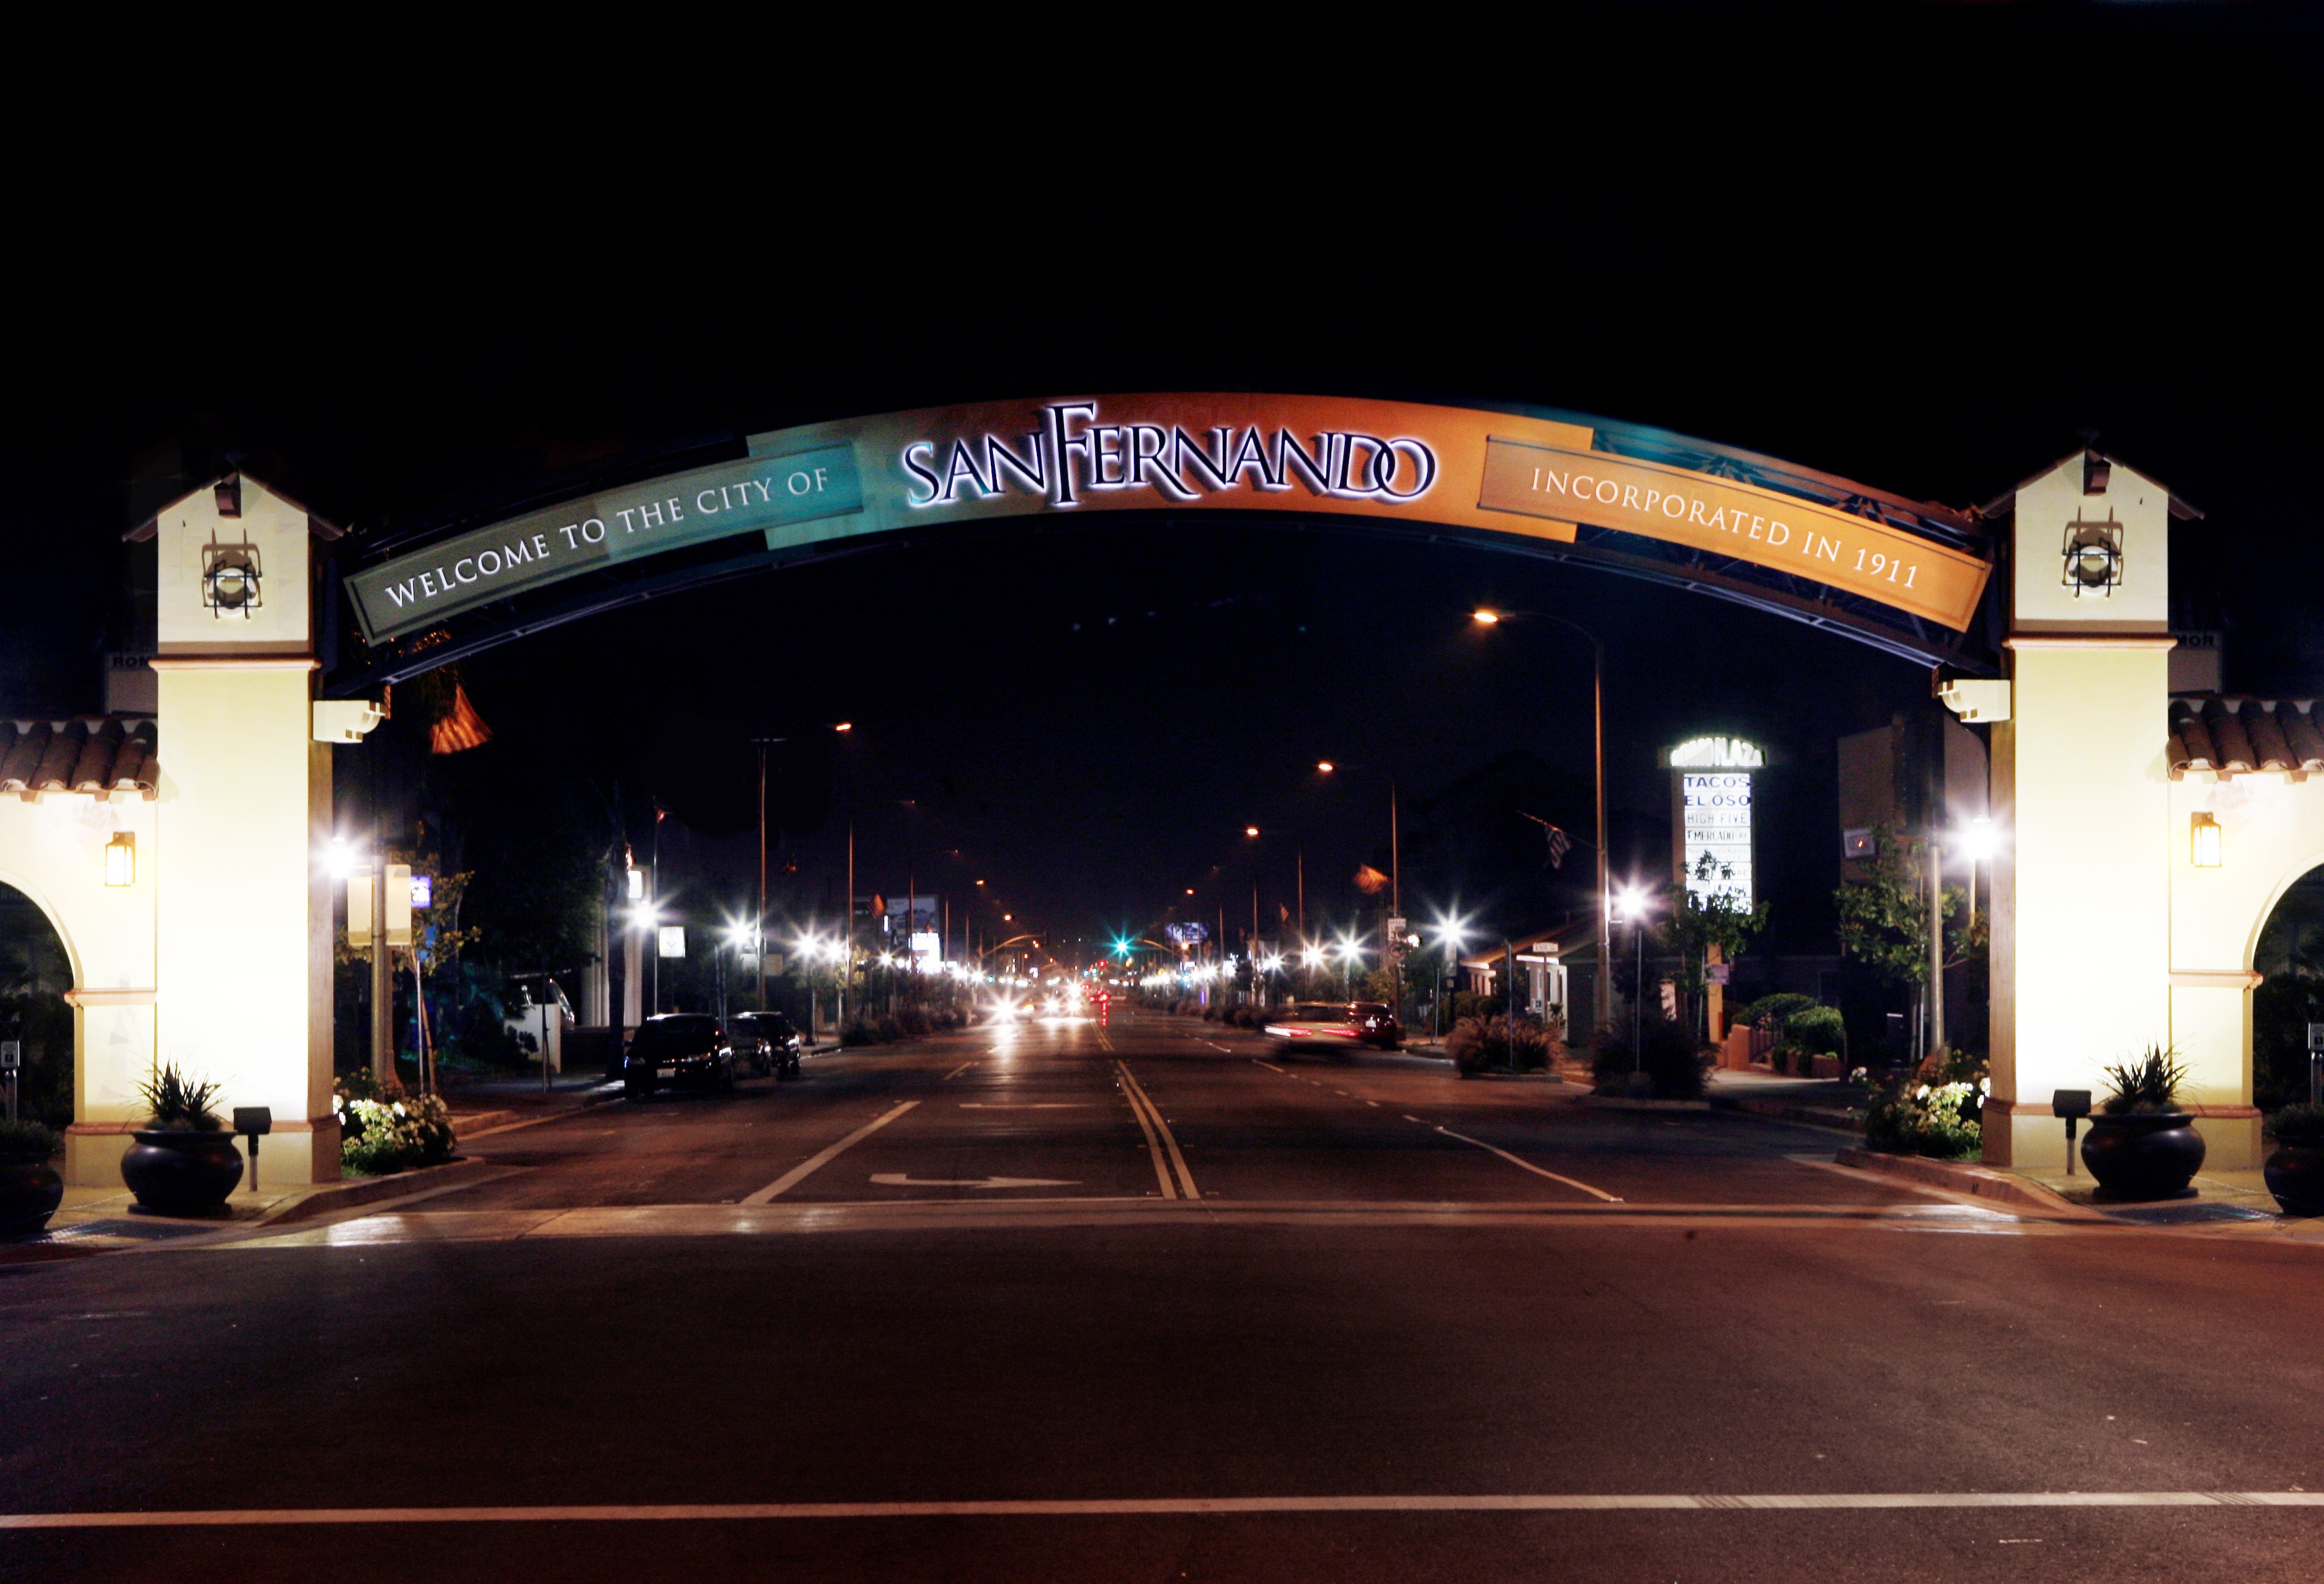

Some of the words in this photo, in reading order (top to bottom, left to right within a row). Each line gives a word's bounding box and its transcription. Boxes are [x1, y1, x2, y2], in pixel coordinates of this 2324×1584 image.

[903, 433, 1046, 507] SAN
[1048, 401, 1437, 505] FERNANDO
[1531, 468, 1790, 546] INCORPORATED
[1801, 531, 1841, 562] IN
[1853, 548, 1917, 589] 1911
[385, 534, 550, 608] WELCOME
[559, 519, 606, 549] TO
[616, 498, 684, 534] THE
[696, 477, 772, 514] CITY
[787, 468, 829, 496] OF
[1684, 776, 1751, 787] TACOS
[1685, 795, 1706, 806] EL
[1712, 795, 1751, 806] OSO
[1688, 813, 1714, 824] HIGH
[1720, 813, 1748, 824] FIVE
[1694, 831, 1735, 841] MERCADO
